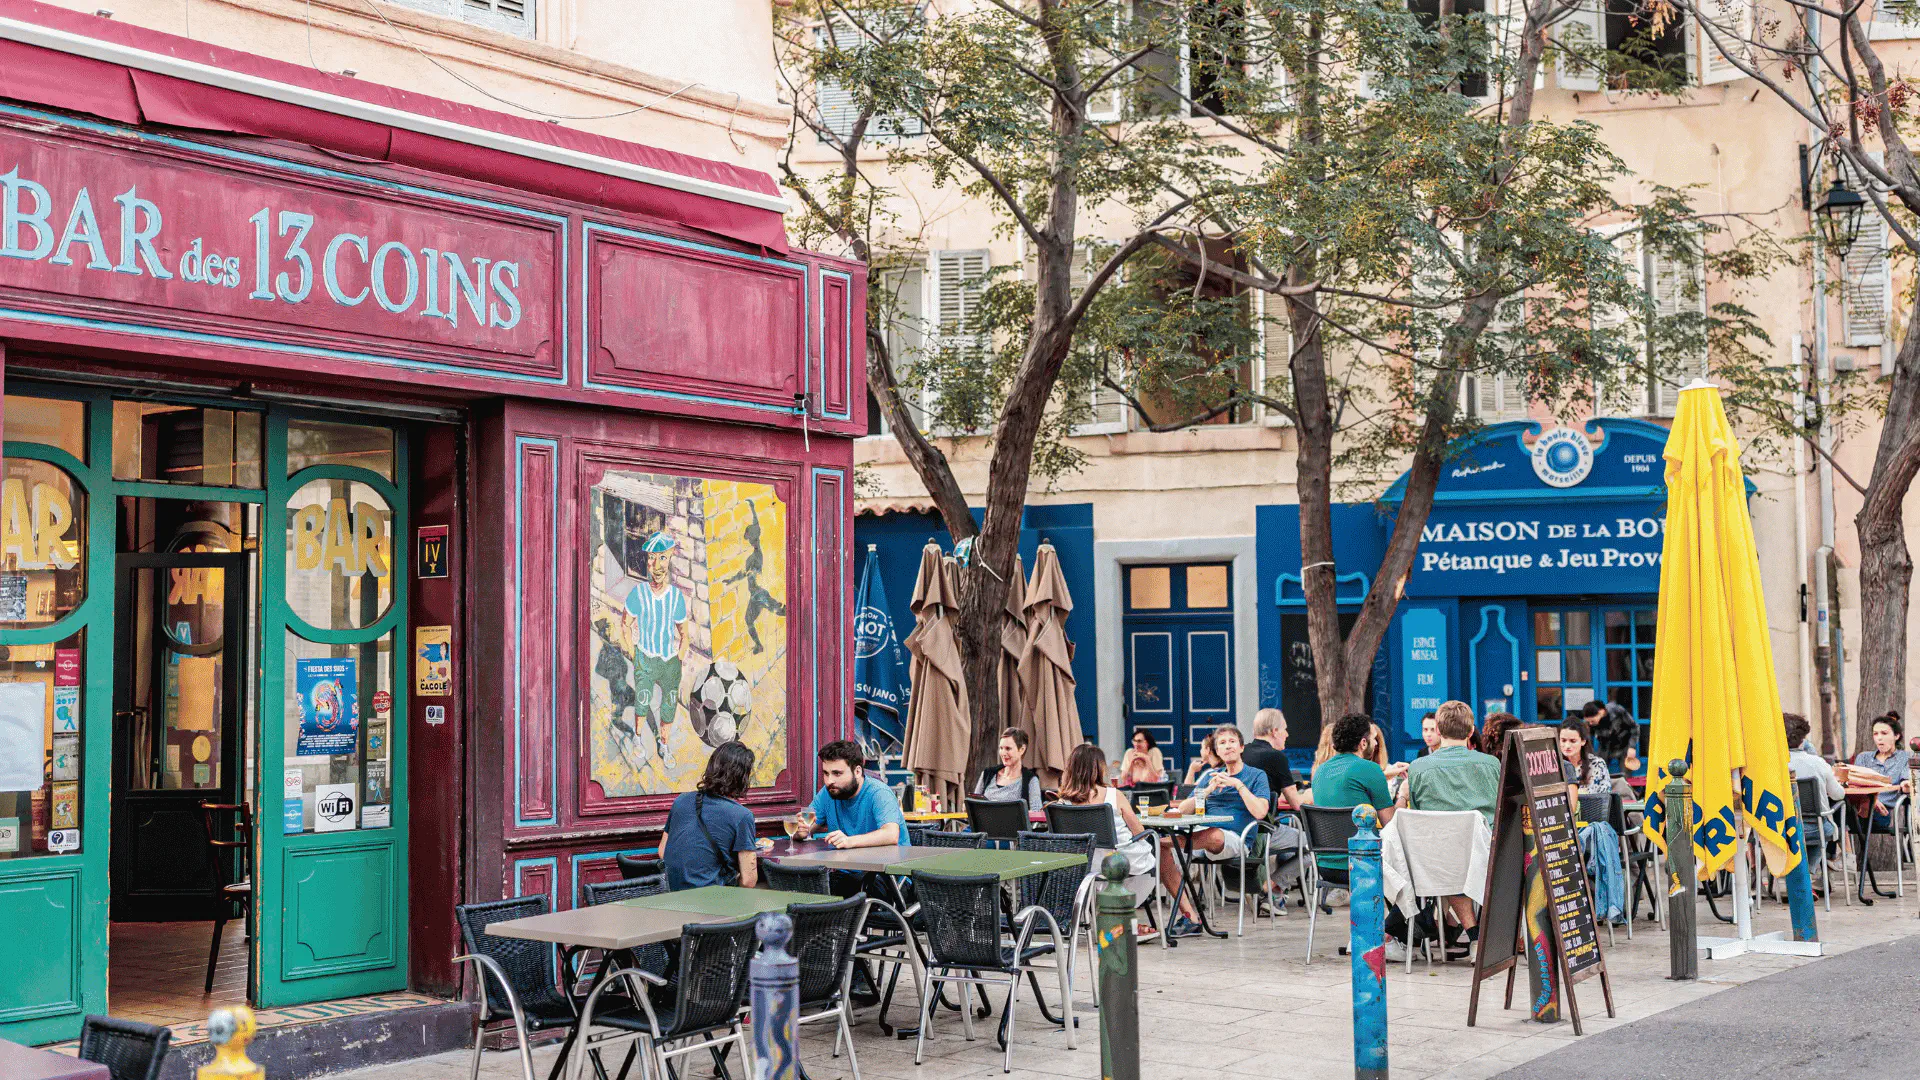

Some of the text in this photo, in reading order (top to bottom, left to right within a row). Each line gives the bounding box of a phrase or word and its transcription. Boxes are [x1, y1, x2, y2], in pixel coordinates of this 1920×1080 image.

[0, 163, 522, 329] BAR des 13 COINS
[1534, 429, 1590, 457] la boule bleue
[1623, 454, 1657, 464] DEPUIS
[1542, 468, 1585, 483] marseille
[292, 498, 389, 577] BAR
[1419, 521, 1540, 542] MAISON
[1548, 524, 1576, 538] DE
[1583, 523, 1611, 538] LA
[1422, 551, 1532, 573] Pétanque
[1538, 556, 1554, 568] &
[1557, 549, 1598, 568] Jeu
[1417, 673, 1434, 684] FILM
[320, 800, 350, 813] WiFi
